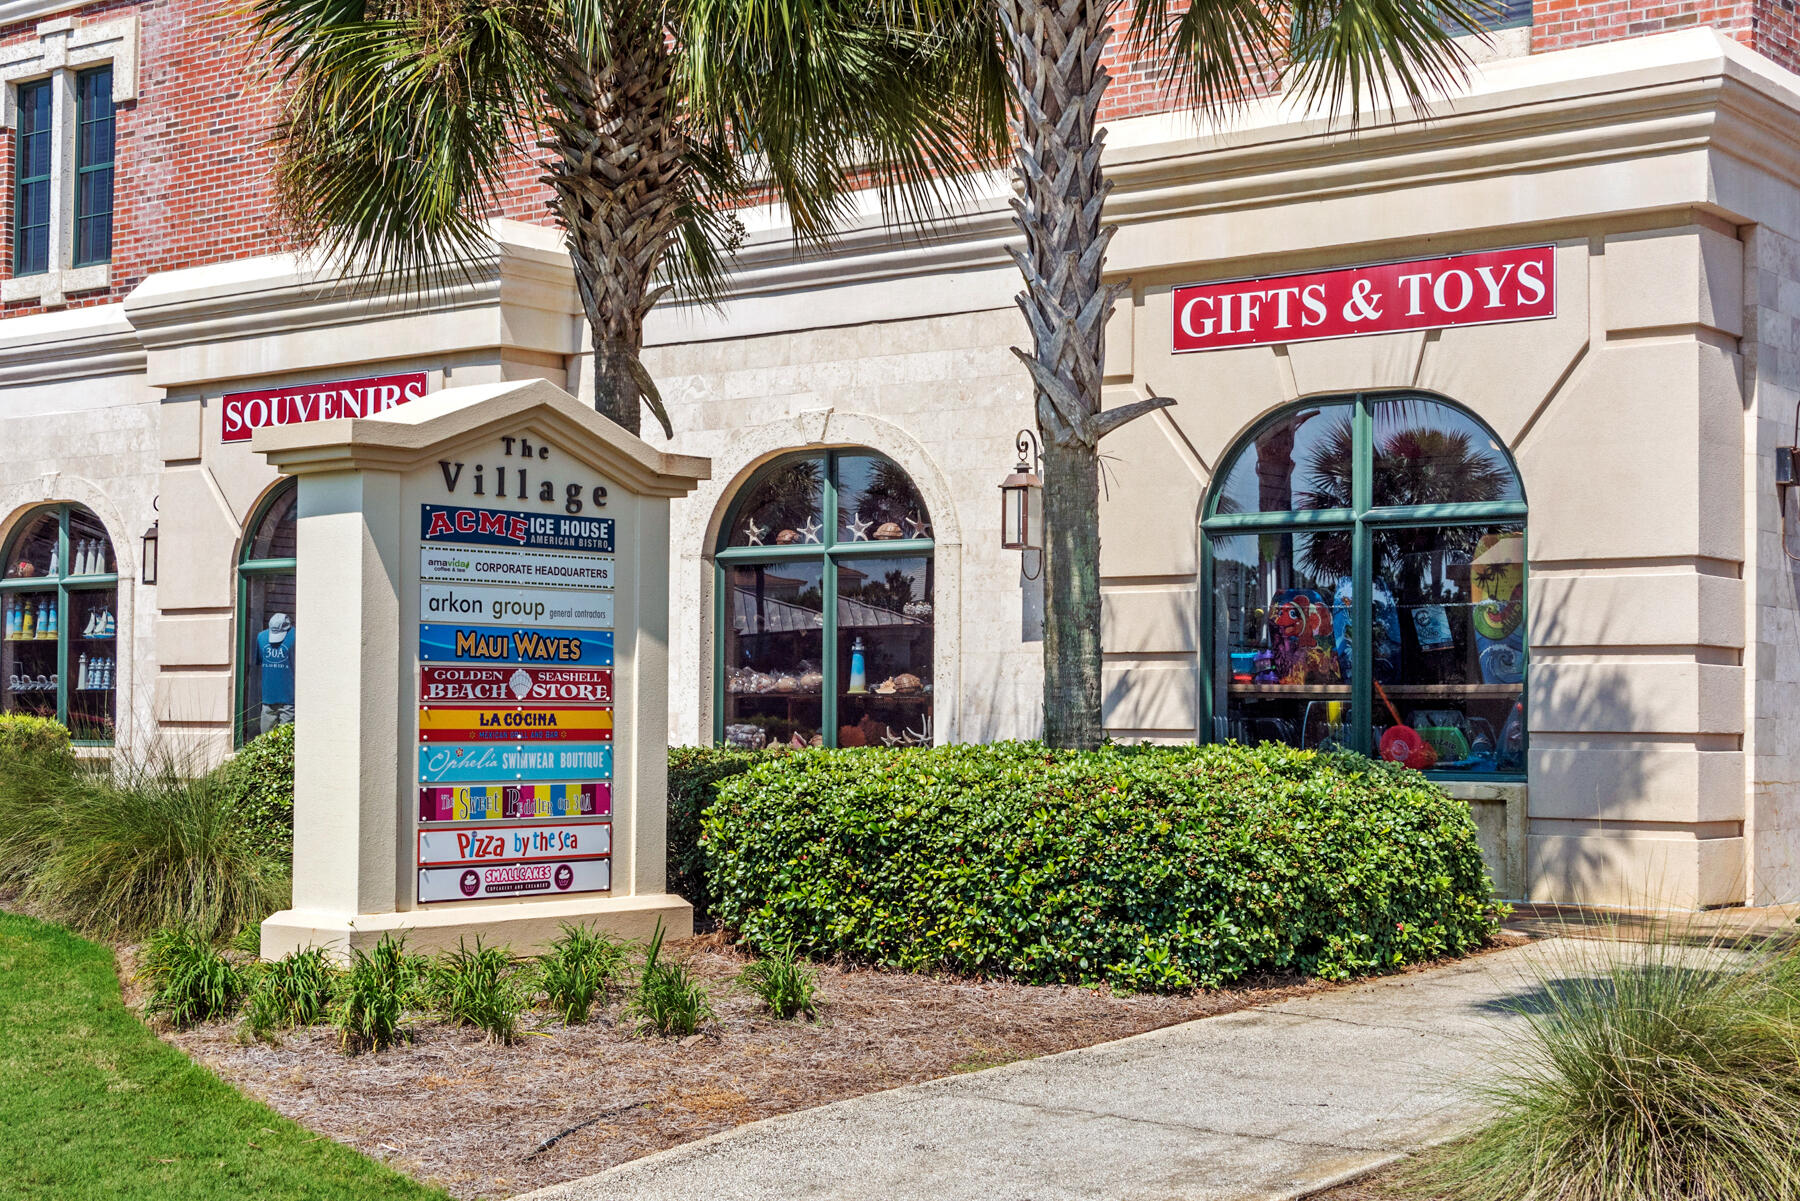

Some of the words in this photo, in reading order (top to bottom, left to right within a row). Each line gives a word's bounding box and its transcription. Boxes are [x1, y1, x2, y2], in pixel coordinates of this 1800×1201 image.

[1180, 284, 1327, 338] GIFTS
[1342, 279, 1383, 322] &
[1398, 260, 1547, 317] TOYS
[501, 436, 549, 460] The
[438, 460, 608, 514] Village
[428, 510, 529, 542] ACME
[530, 517, 555, 535] ICE
[560, 519, 608, 539] HOUSE
[530, 535, 576, 547] AMERICAN
[578, 538, 609, 549] BISTRO
[428, 557, 466, 568] amavida
[475, 562, 533, 575] CORPORATE
[534, 565, 608, 579] HEADQUARTERS
[429, 591, 483, 613] arkon
[492, 600, 545, 620] group
[549, 608, 573, 620] general
[574, 609, 606, 619] contractors
[265, 647, 285, 658] 30A
[434, 670, 503, 681] GOLDEN
[538, 672, 601, 682] SEASHELL
[428, 683, 508, 699] BEACH
[532, 684, 607, 700] STORE
[479, 713, 502, 727] LA
[503, 713, 557, 727] COCINA
[479, 731, 508, 739] MEXICAN
[530, 731, 544, 739] AND
[428, 748, 499, 781] Ophelia
[502, 752, 555, 769] SWIMWEAR
[560, 752, 604, 768] BOUTIQUE
[457, 831, 505, 858] Pizza
[514, 832, 530, 856] by
[533, 831, 555, 851] the
[485, 866, 552, 883] SMALLCAKES
[525, 882, 549, 890] CREAMERY
